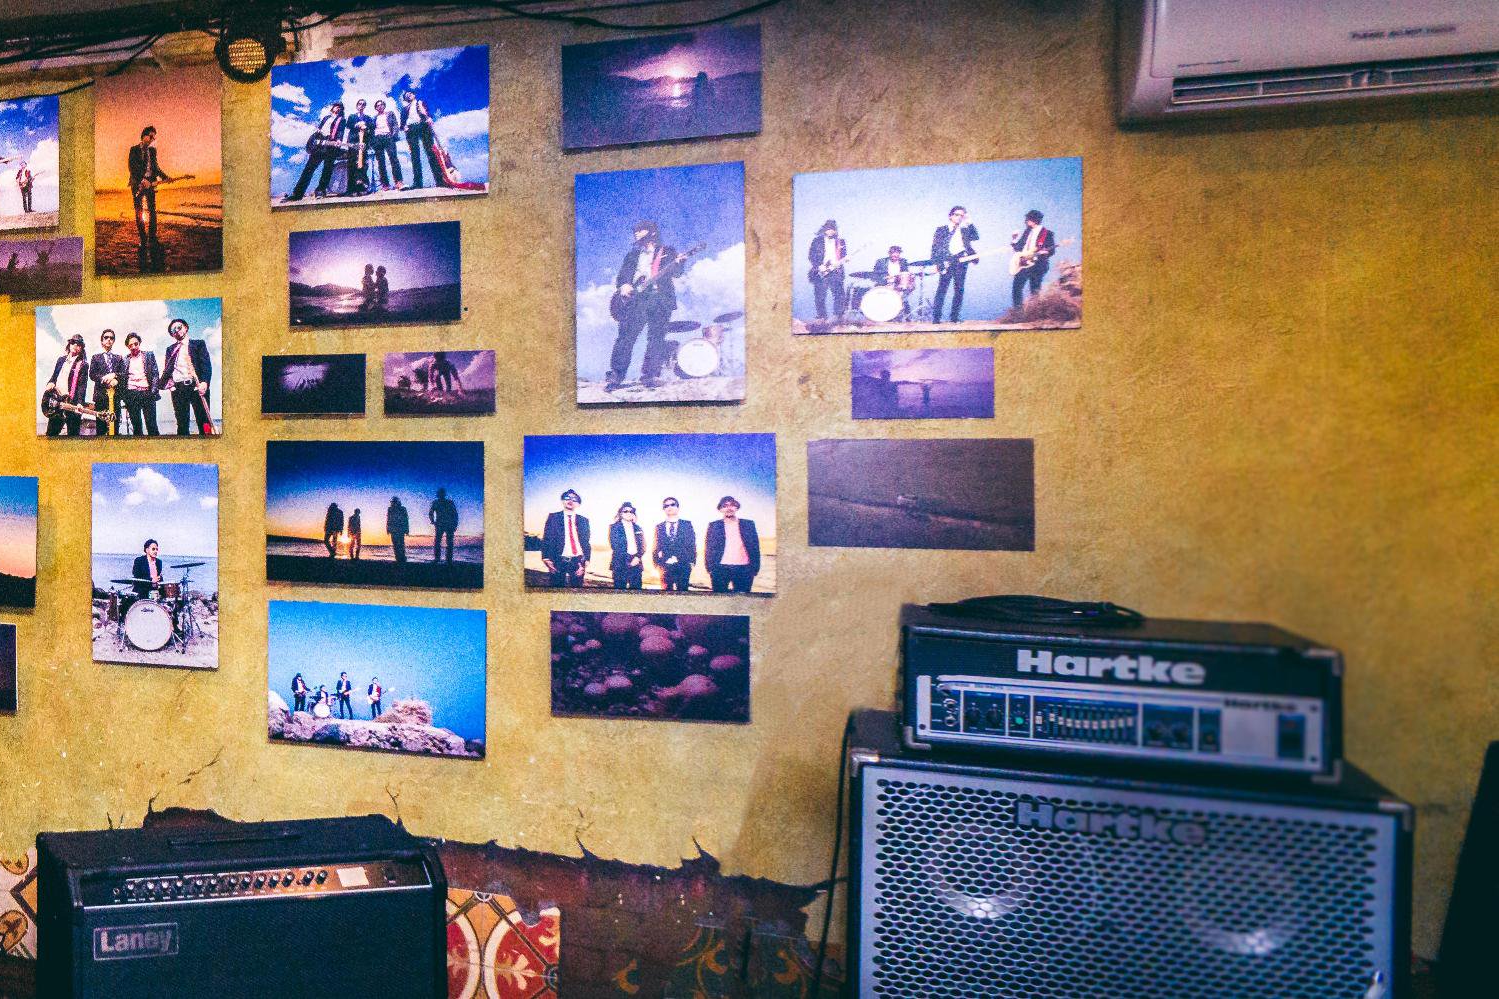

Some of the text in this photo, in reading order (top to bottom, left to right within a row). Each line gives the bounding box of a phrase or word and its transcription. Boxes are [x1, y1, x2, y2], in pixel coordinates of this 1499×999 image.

[1017, 649, 1206, 685] Hartke
[1016, 800, 1206, 845] Hartke
[100, 929, 173, 953] Laney
